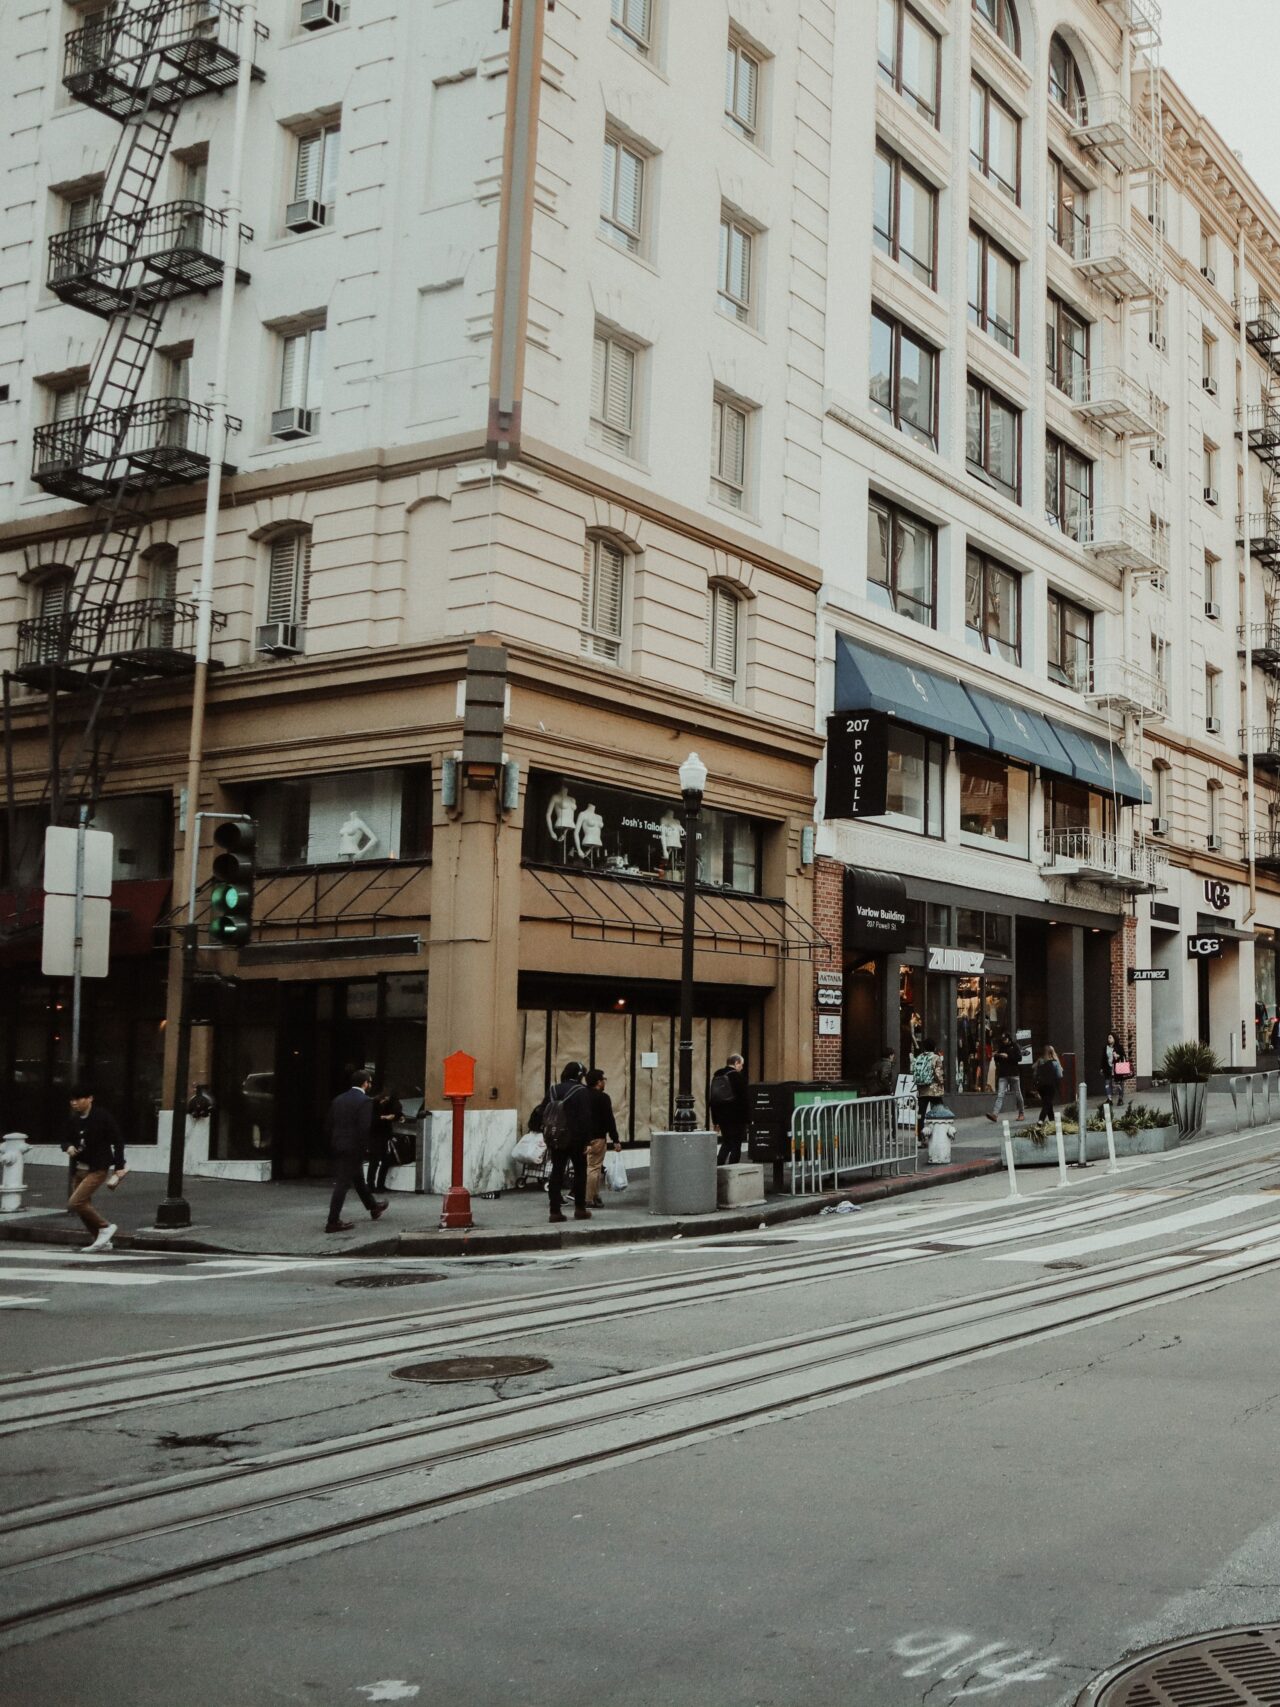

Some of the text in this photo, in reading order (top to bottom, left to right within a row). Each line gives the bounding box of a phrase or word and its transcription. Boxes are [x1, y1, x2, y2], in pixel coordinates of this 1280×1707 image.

[846, 719, 869, 812] 207 POWELL
[621, 816, 643, 829] Josh's
[1203, 880, 1231, 911] UGG
[856, 905, 905, 924] Varlow Building
[866, 920, 875, 928] 207
[876, 922, 891, 930] Powell
[1188, 938, 1220, 954] UGG
